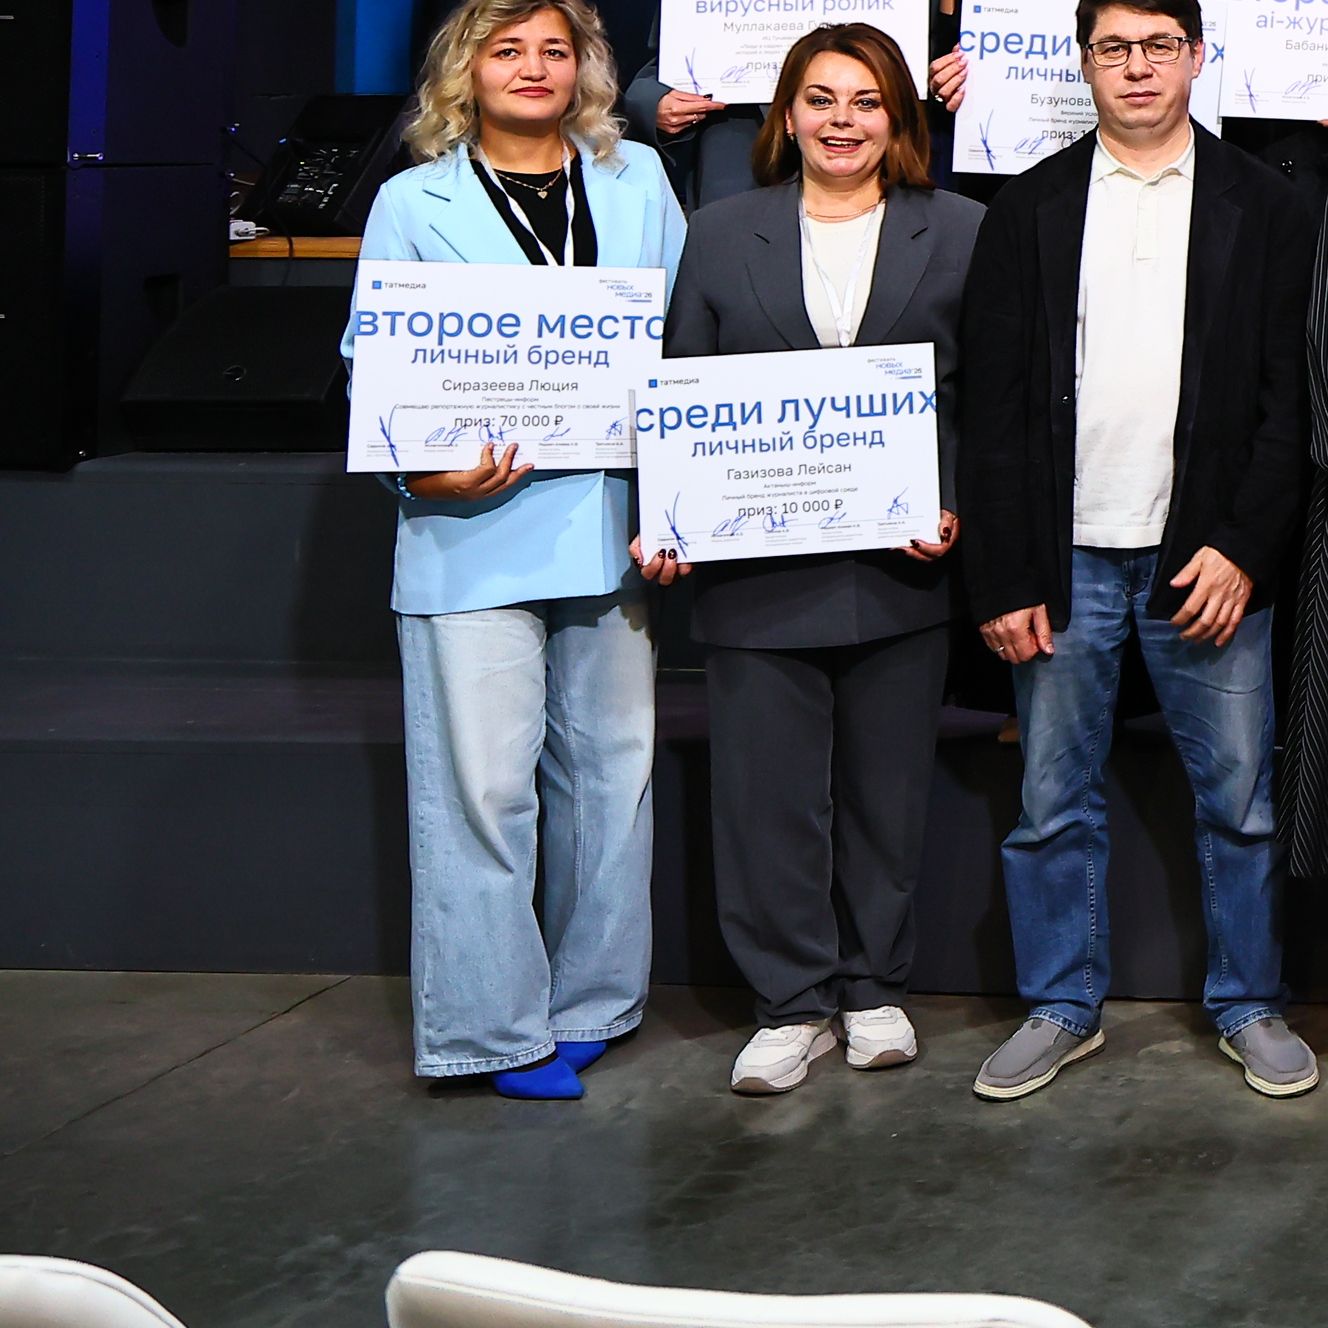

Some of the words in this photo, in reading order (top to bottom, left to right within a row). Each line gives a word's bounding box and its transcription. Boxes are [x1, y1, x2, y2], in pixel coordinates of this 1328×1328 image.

[724, 21, 804, 32] Муллакаева
[959, 30, 1071, 60] среди
[1006, 66, 1081, 82] личны
[1031, 94, 1091, 107] Бузунова
[355, 311, 521, 346] второе
[538, 314, 664, 340] место
[412, 344, 517, 365] личный
[528, 345, 609, 369] бренд
[442, 380, 524, 394] Сиразеева
[529, 380, 578, 393] Люция
[660, 377, 699, 385] татмедиа
[455, 416, 495, 428] приз:
[500, 416, 517, 427] 70
[522, 416, 549, 427] 000
[554, 416, 563, 425] ₽
[636, 402, 762, 439] среди
[777, 390, 937, 428] лучших
[692, 431, 794, 457] личный
[803, 429, 885, 455] бренд
[727, 467, 793, 481] Газизова
[797, 462, 852, 477] Лейсан
[738, 505, 778, 519] приз:
[782, 503, 797, 515] 10
[802, 501, 830, 513] 000
[834, 499, 843, 509] ₽
